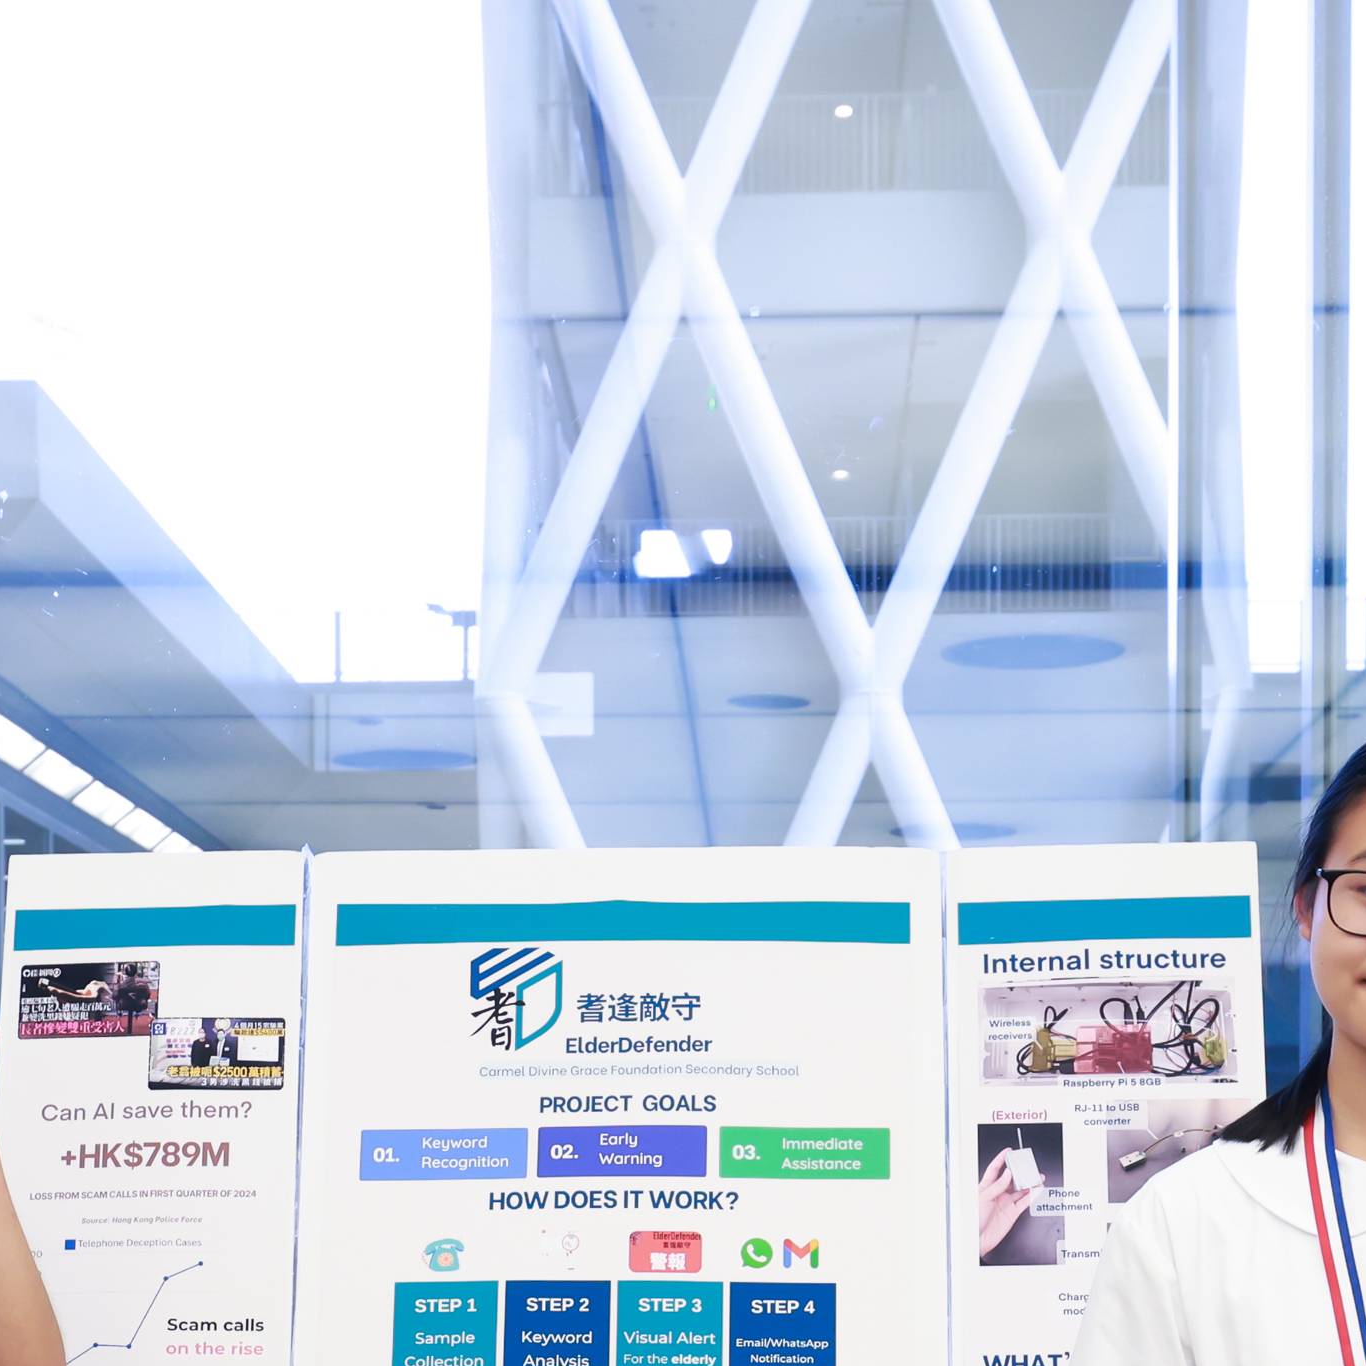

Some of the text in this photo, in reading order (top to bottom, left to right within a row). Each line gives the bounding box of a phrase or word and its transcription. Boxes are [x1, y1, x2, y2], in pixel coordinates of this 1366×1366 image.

[984, 949, 1226, 974] Internal structure
[577, 992, 701, 1023] 耆逢敵守
[566, 1035, 712, 1053] ElderDefender
[1063, 1078, 1161, 1088] Raspberry Pi 5 8GB
[42, 1100, 252, 1121] Can AI save them?
[540, 1095, 716, 1113] PROJECT GOALS
[1075, 1104, 1103, 1112] RJ-11
[993, 1110, 1049, 1124] (Exterior)
[373, 1136, 489, 1162] 01. Keyword
[550, 1133, 637, 1159] 02. Early
[732, 1138, 863, 1160] 03. Immediate
[61, 1140, 229, 1170] +HK$789M
[599, 1153, 664, 1167] Warning
[421, 1155, 508, 1171] Recognition
[782, 1158, 861, 1170] Assistance
[82, 1191, 107, 1199] SCAM
[139, 1190, 148, 1198] IN
[234, 1190, 256, 1198] 2024
[1047, 1187, 1079, 1197] Phone
[489, 1190, 739, 1210] HOW DOES IT WORK?
[1037, 1203, 1092, 1211] attachment
[415, 1298, 477, 1313] STEP 1
[527, 1298, 589, 1312] STEP 2
[639, 1298, 702, 1312] STEP 3
[751, 1300, 815, 1314] STEP 4
[168, 1319, 264, 1331] Scam calls
[415, 1331, 475, 1347] Sample
[522, 1331, 592, 1346] Keyword
[624, 1331, 716, 1344] Visual Alert
[736, 1337, 828, 1349] Email/WhatsApp
[166, 1341, 263, 1355] on the rise
[624, 1353, 716, 1366] For the elderly
[751, 1354, 814, 1363] Notification
